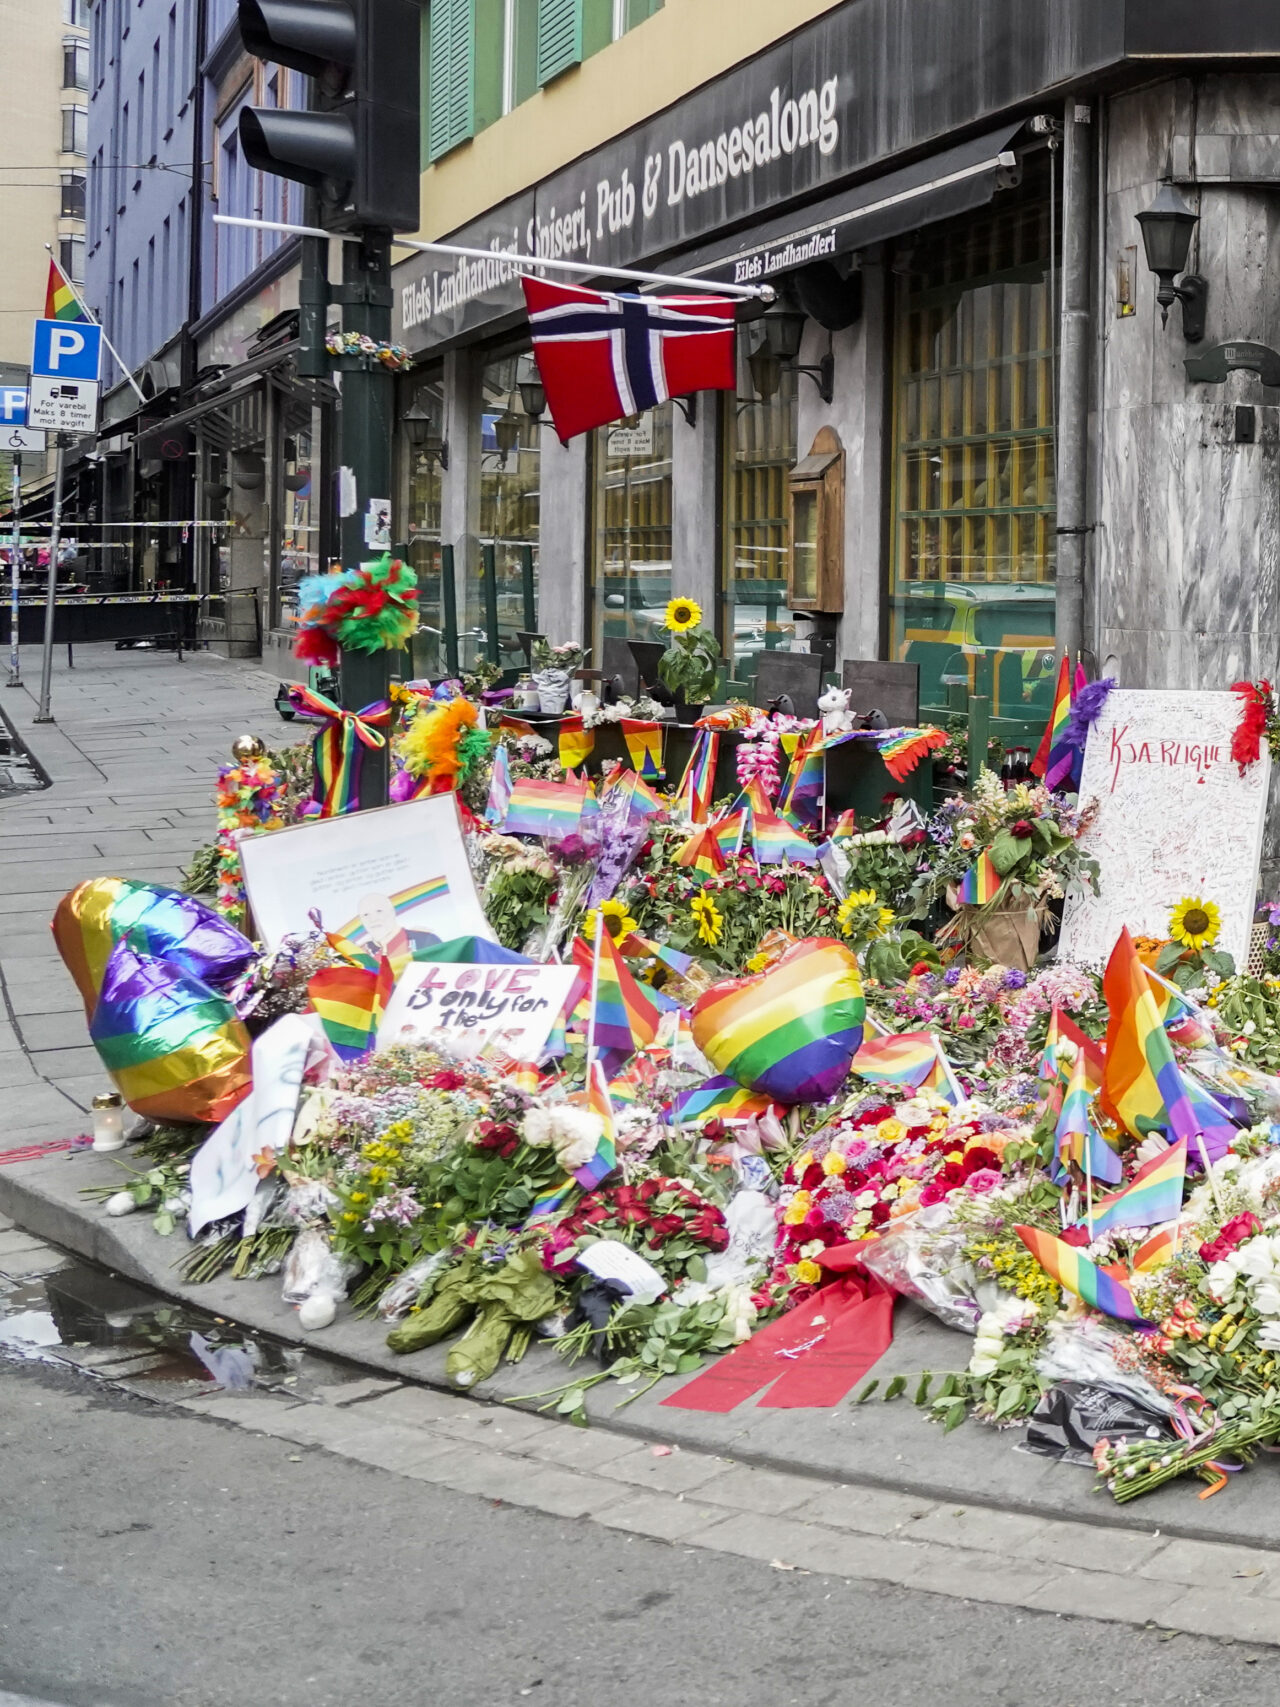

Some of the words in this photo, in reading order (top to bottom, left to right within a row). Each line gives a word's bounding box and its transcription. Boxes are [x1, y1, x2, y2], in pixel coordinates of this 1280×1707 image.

[402, 277, 431, 330] Eilefs
[526, 191, 592, 278] Spiseri,
[597, 168, 636, 240] Pub
[642, 151, 662, 219] &
[667, 74, 838, 207] Dansesalong
[734, 256, 763, 284] Eilefs
[764, 228, 836, 274] Landhandleri
[48, 327, 85, 370] P
[4, 390, 30, 420] P
[33, 408, 56, 417] Maks
[60, 410, 66, 418] 8
[70, 412, 92, 420] timer
[40, 400, 55, 408] For
[59, 402, 87, 410] varebil
[39, 418, 56, 426] mot
[60, 419, 86, 428] avgift
[418, 967, 541, 994] LOVE
[406, 988, 433, 1010] is
[439, 989, 513, 1019] only
[511, 994, 549, 1013] for
